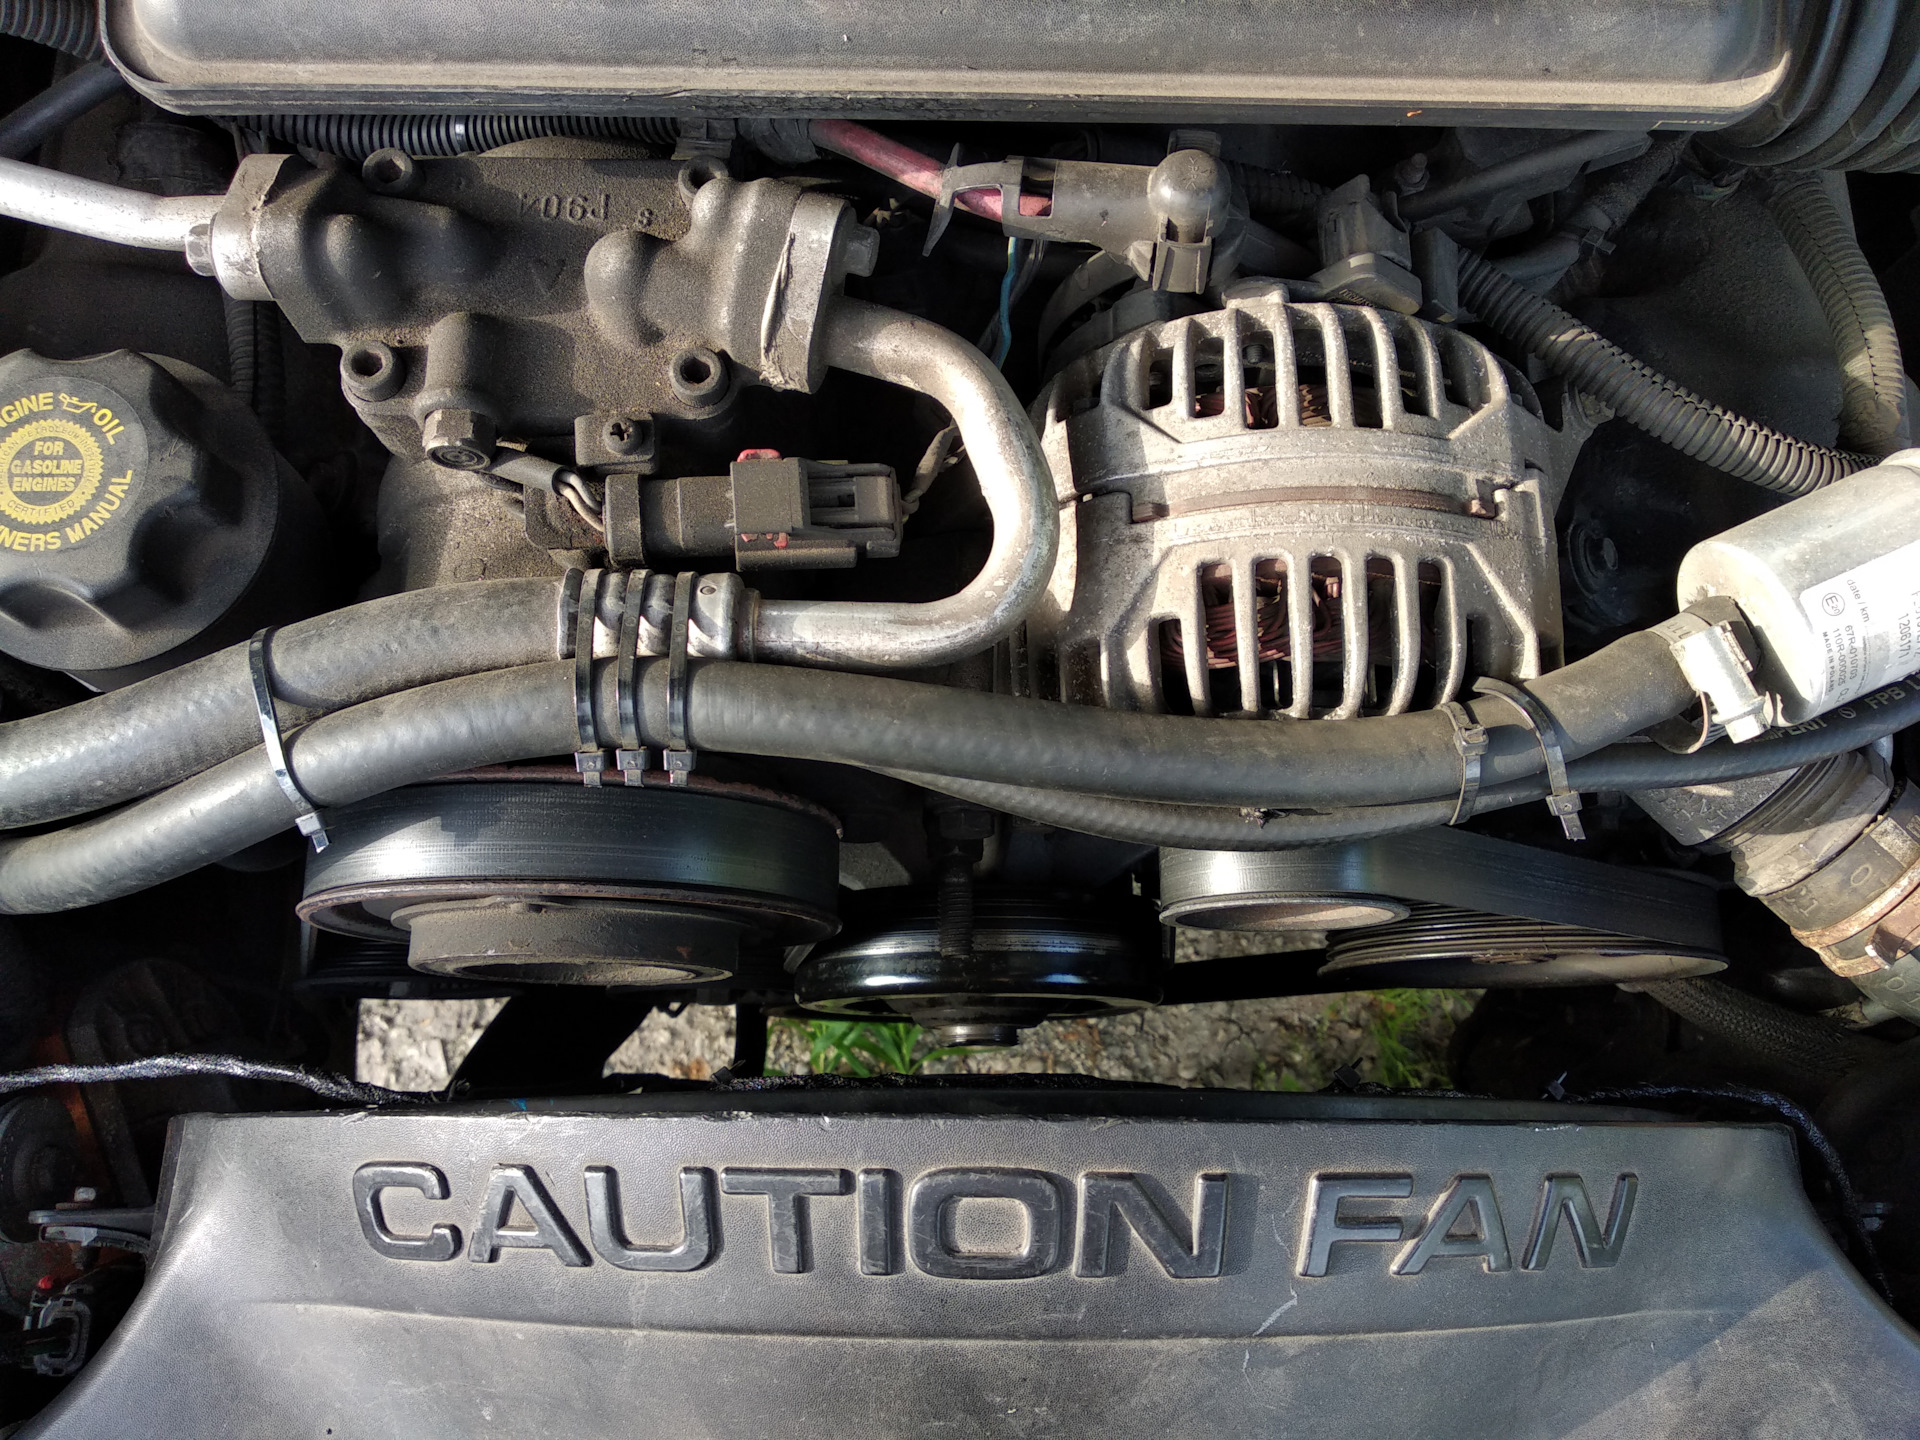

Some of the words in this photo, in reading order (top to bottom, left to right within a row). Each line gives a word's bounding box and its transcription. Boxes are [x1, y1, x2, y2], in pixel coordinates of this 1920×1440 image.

[93, 408, 125, 445] OIL
[34, 441, 65, 455] FOR
[11, 459, 83, 474] GASOLINE
[12, 476, 76, 491] ENGINES
[7, 499, 75, 517] CERTIFIED
[65, 469, 133, 543] MANUAL
[1859, 606, 1871, 623] km
[1865, 685, 1906, 710] FPB
[352, 1160, 1229, 1280] CAUTION
[1295, 1171, 1640, 1278] FAN
